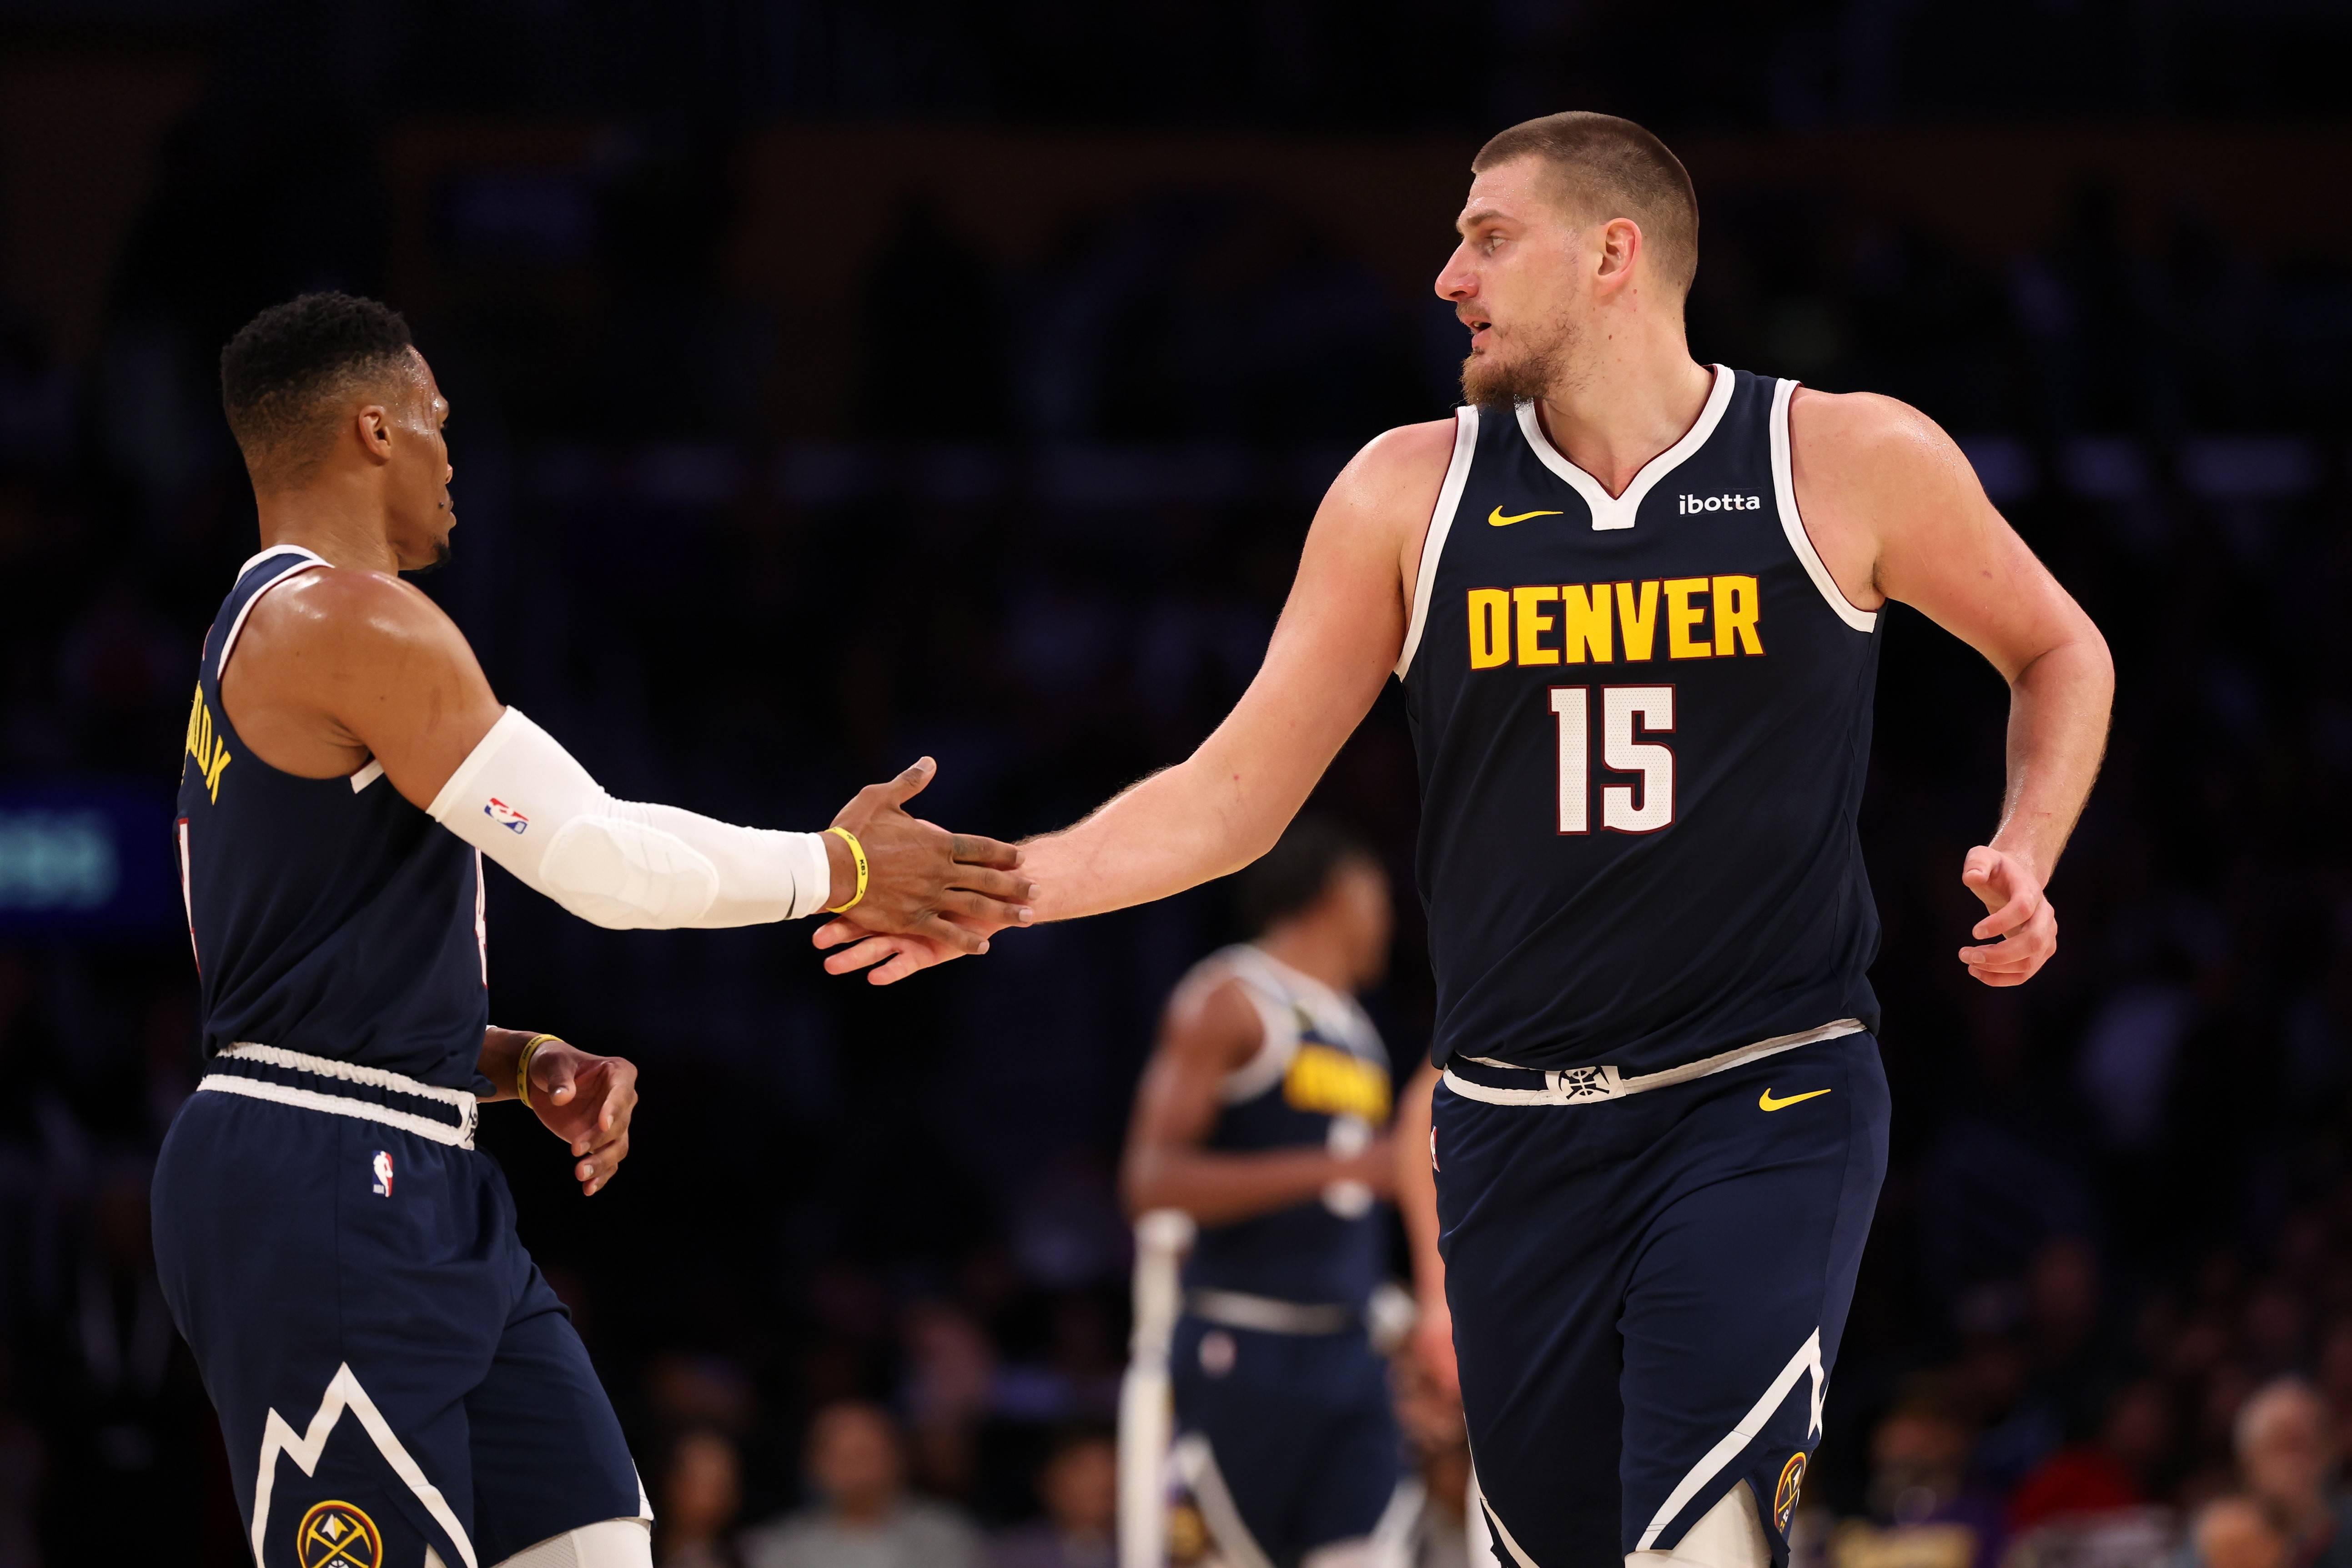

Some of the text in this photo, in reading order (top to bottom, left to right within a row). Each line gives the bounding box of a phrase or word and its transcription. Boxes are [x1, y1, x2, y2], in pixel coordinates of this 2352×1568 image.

[1679, 494, 1761, 515] ibotta
[1467, 574, 1766, 671] DENVER
[1548, 683, 1676, 835] 15
